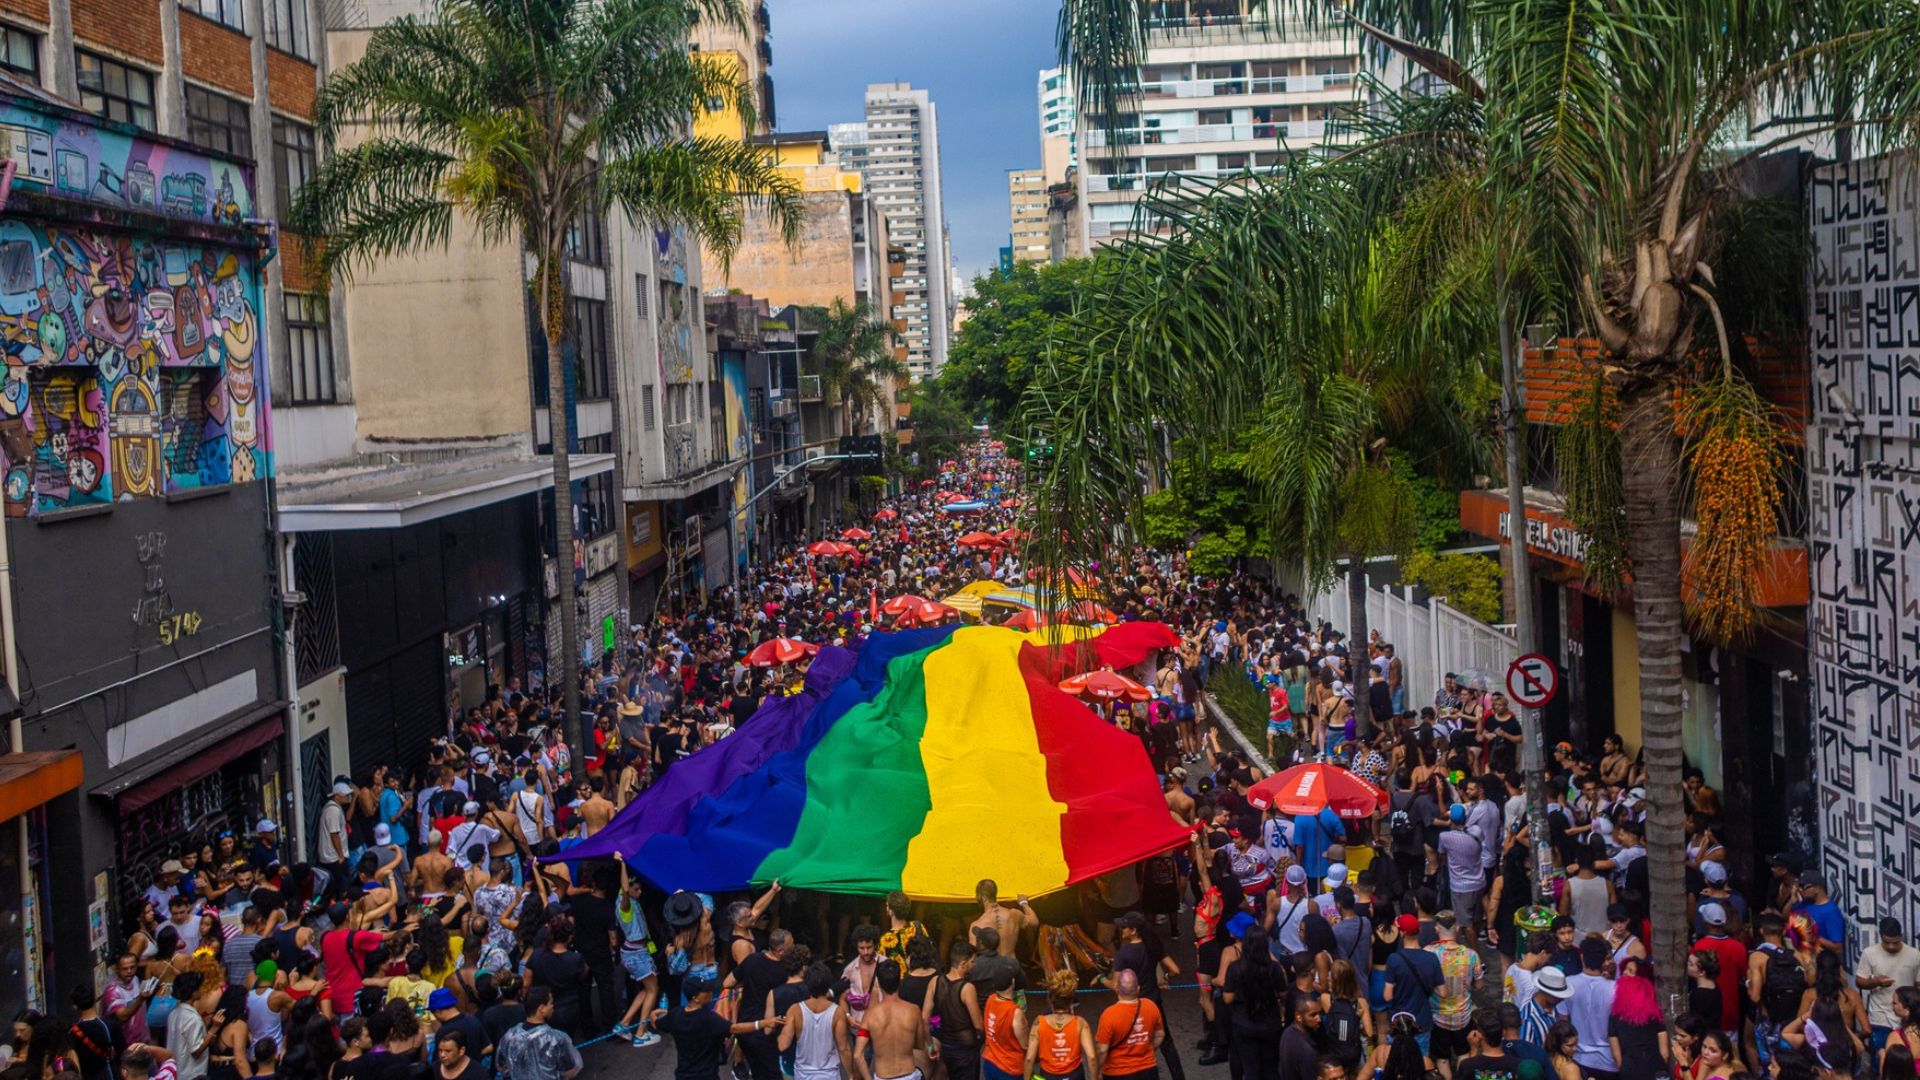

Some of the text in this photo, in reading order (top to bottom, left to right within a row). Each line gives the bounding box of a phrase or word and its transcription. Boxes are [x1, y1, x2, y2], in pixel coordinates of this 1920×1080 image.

[1568, 639, 1583, 657] 579
[1523, 664, 1543, 697] E
[1271, 833, 1288, 849] 30
